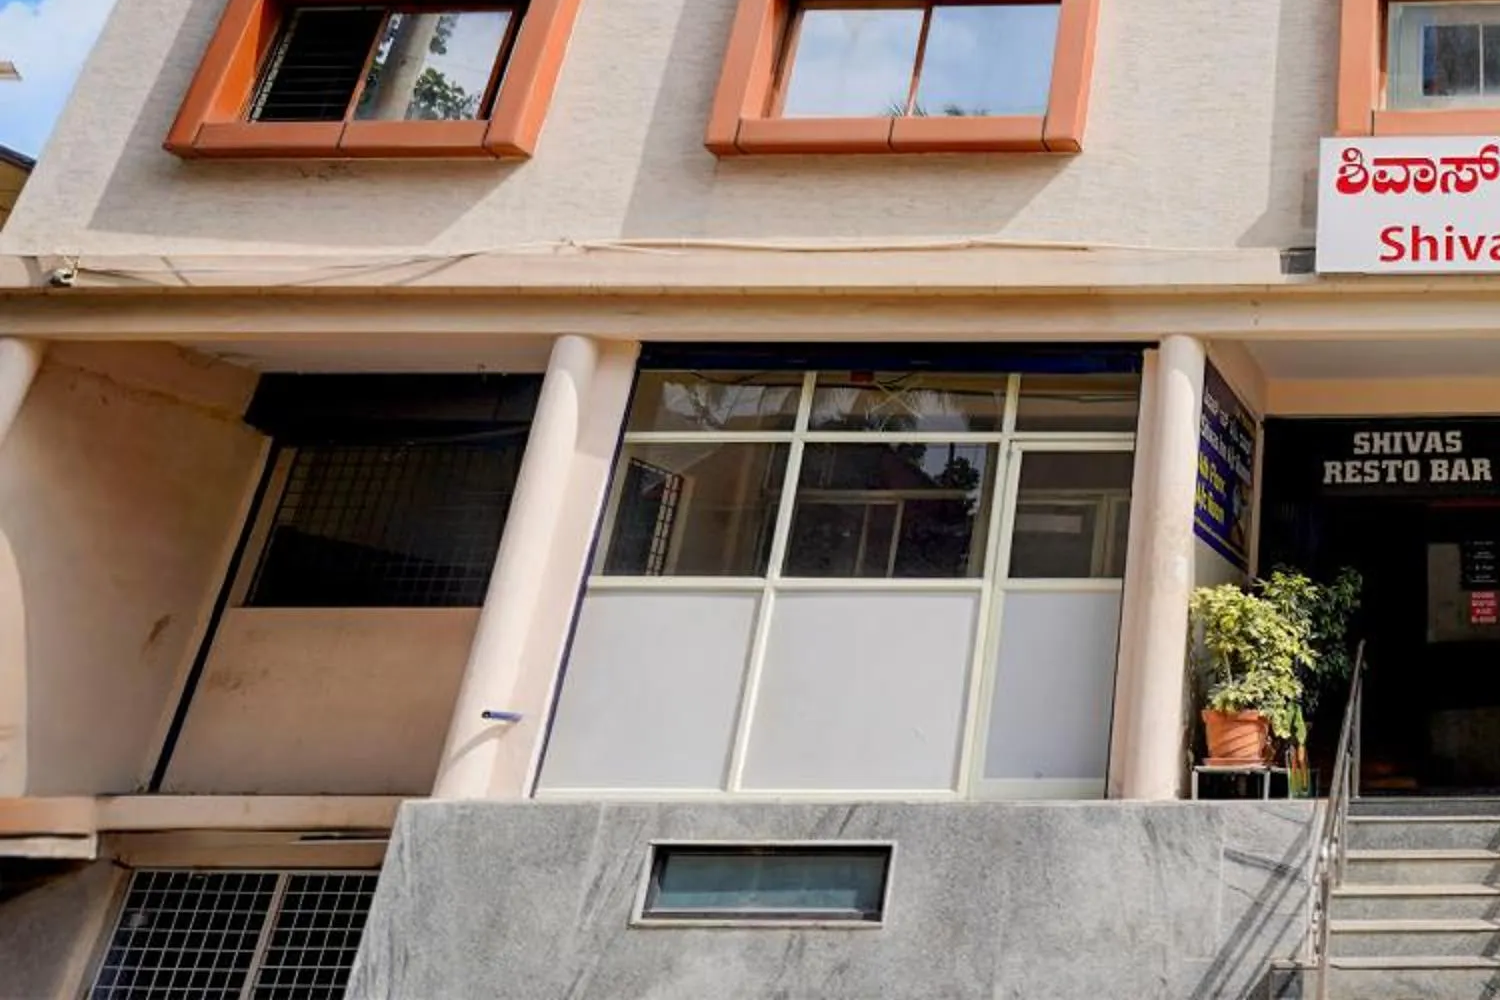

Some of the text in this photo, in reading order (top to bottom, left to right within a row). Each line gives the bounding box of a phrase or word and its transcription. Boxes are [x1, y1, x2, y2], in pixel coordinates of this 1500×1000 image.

[1336, 143, 1500, 194] ಶಿವಾಸ್
[1353, 430, 1462, 455] SHIVAS
[1323, 457, 1492, 484] RESTO BAR
